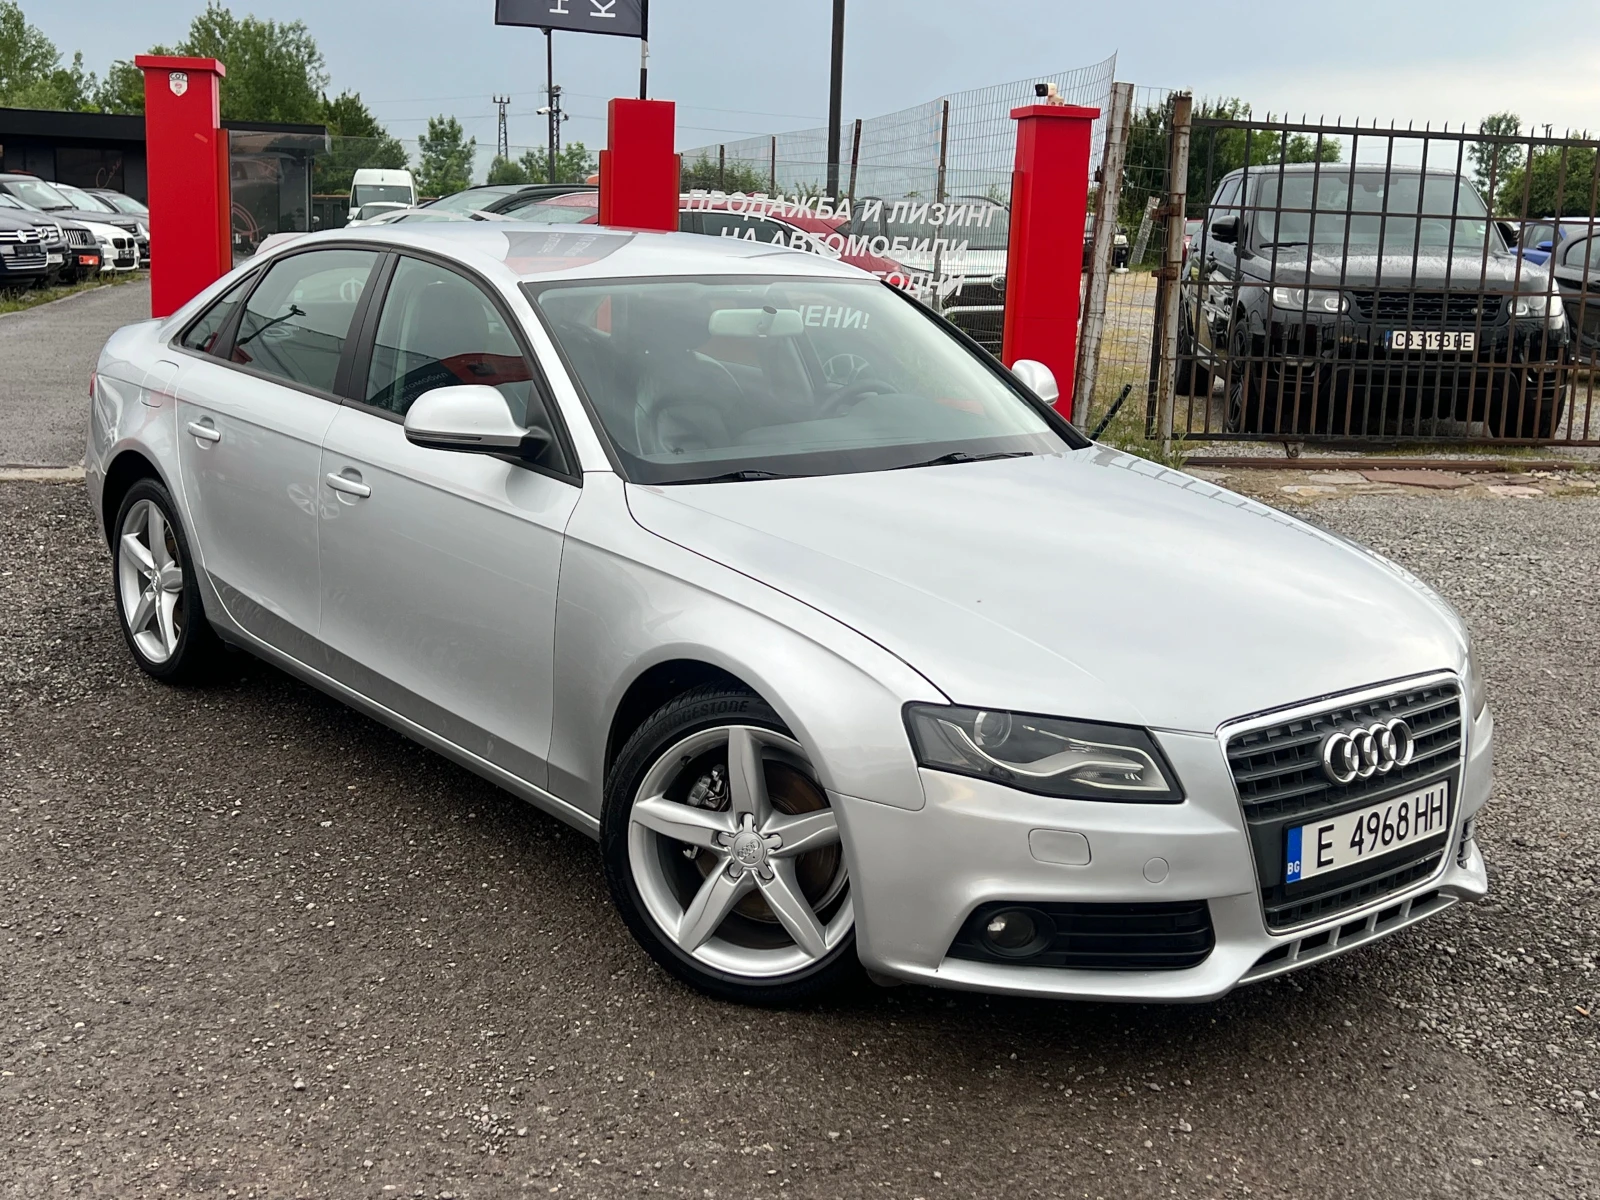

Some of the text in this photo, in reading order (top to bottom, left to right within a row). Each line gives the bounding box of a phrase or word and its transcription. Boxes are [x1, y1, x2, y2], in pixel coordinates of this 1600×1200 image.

[686, 189, 1005, 227] ПРОДАЖБА И ЛИЗИНГ
[770, 230, 969, 261] АВТОМОБИЛИ
[1287, 861, 1301, 875] BG
